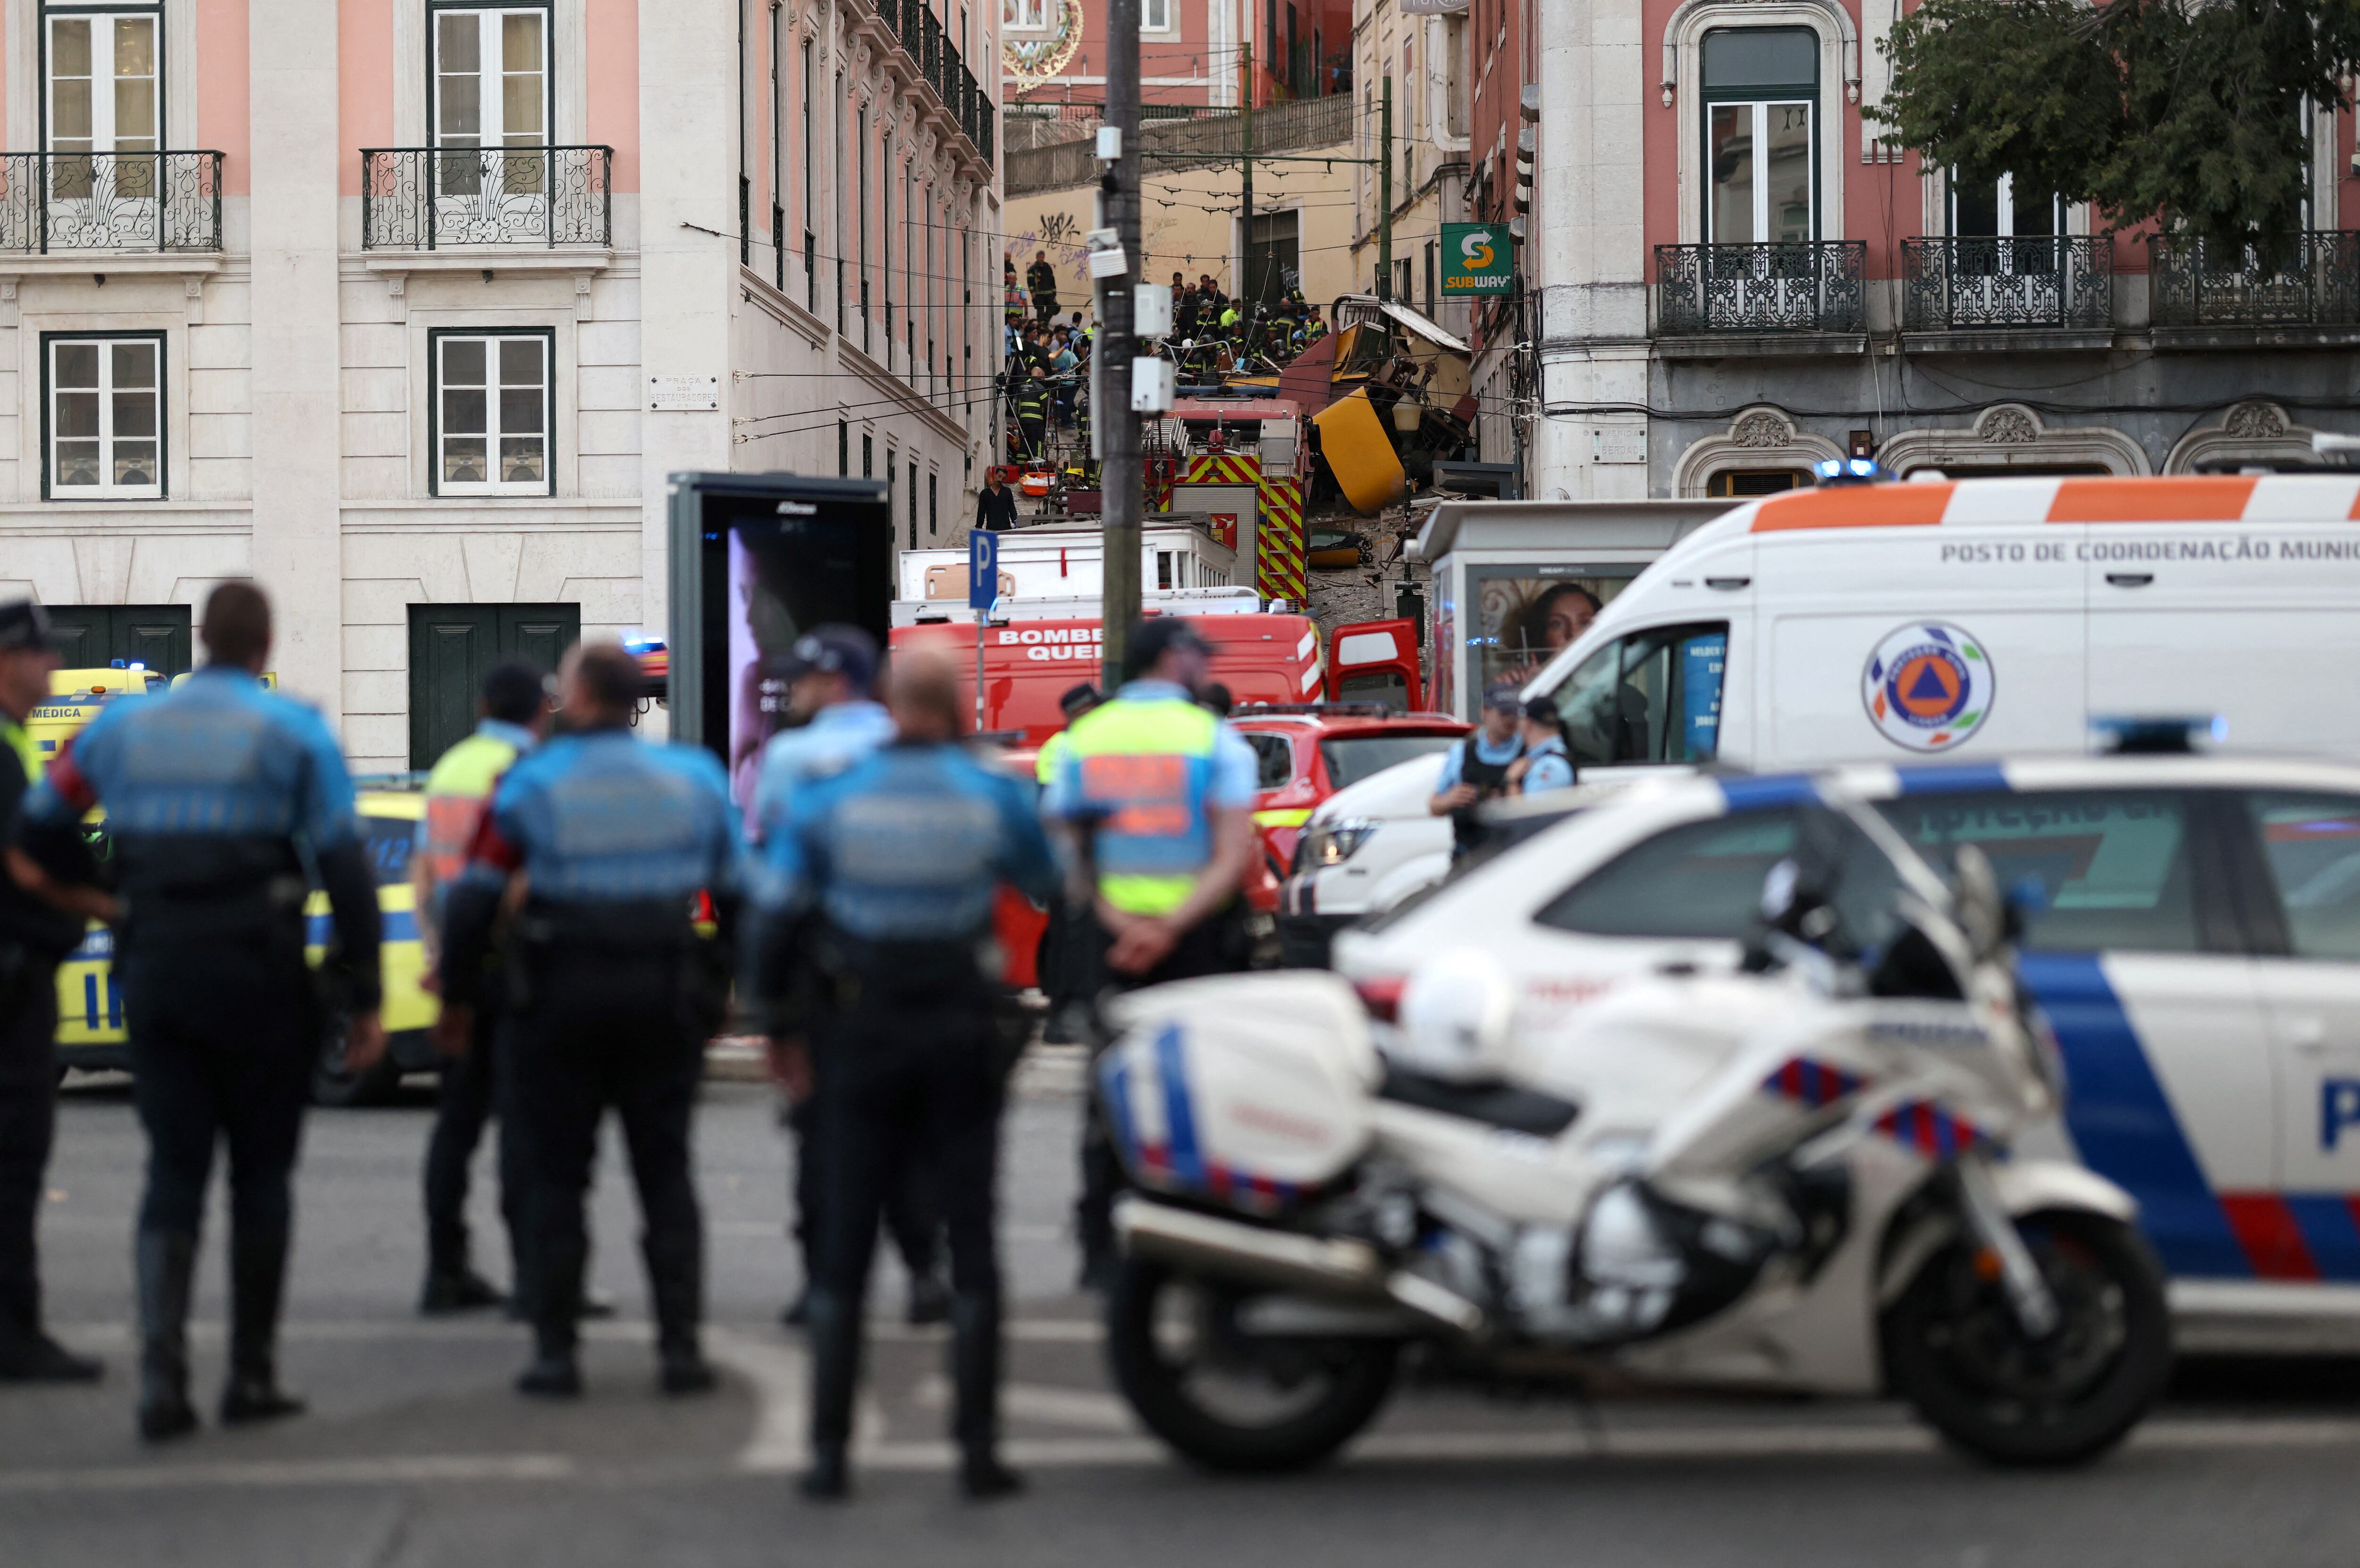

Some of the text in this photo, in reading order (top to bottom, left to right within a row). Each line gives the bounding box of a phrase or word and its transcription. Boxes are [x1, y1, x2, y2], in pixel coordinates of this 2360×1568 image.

[1445, 276, 1510, 288] SUBWAY
[651, 394, 717, 402] RESTAURADORES
[1941, 544, 2025, 562] POSTO
[2035, 543, 2065, 561] DE
[2076, 536, 2271, 562] COORDENAÇÃO
[976, 536, 991, 587] P
[33, 707, 81, 718] MÉDICA
